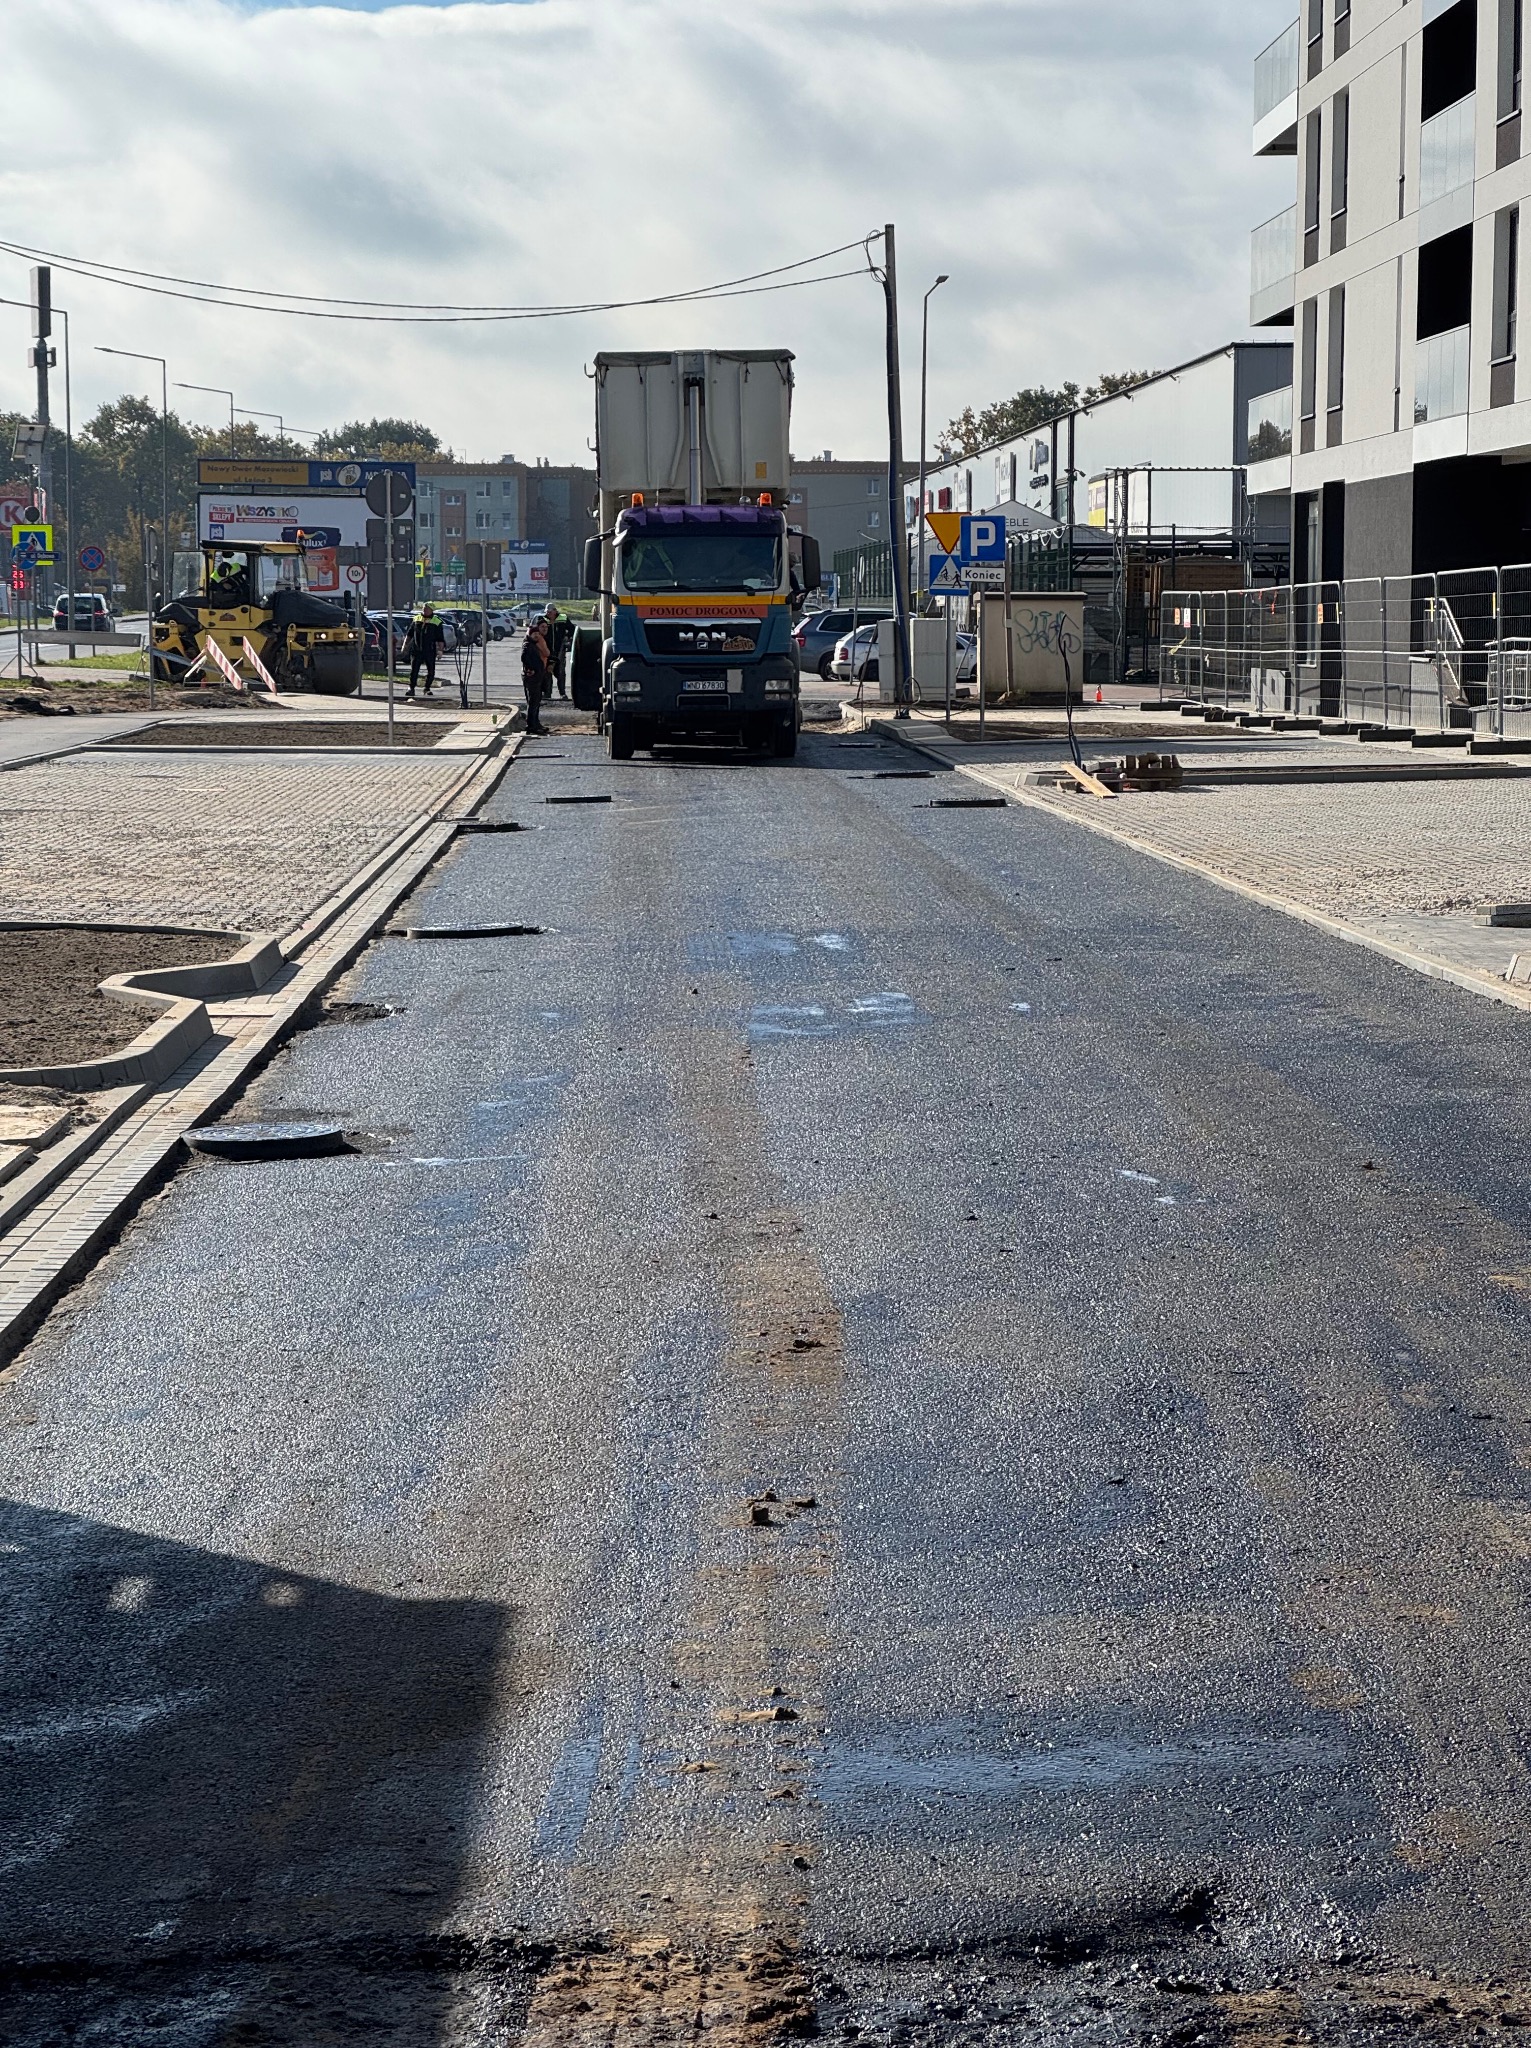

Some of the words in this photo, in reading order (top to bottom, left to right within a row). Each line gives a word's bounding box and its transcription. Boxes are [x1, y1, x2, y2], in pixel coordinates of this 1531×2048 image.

[207, 465, 230, 473] Nowy
[254, 465, 299, 473] Mazowiecki
[4, 505, 23, 525] K
[236, 505, 299, 518] WSZYSTKO
[1005, 517, 1030, 527] EBLE
[970, 520, 996, 557] P
[965, 569, 1002, 580] Koniec
[649, 607, 693, 616] POMOC
[695, 607, 756, 616] DROGOWA
[678, 631, 727, 642] MAN
[702, 681, 725, 690] 67830
